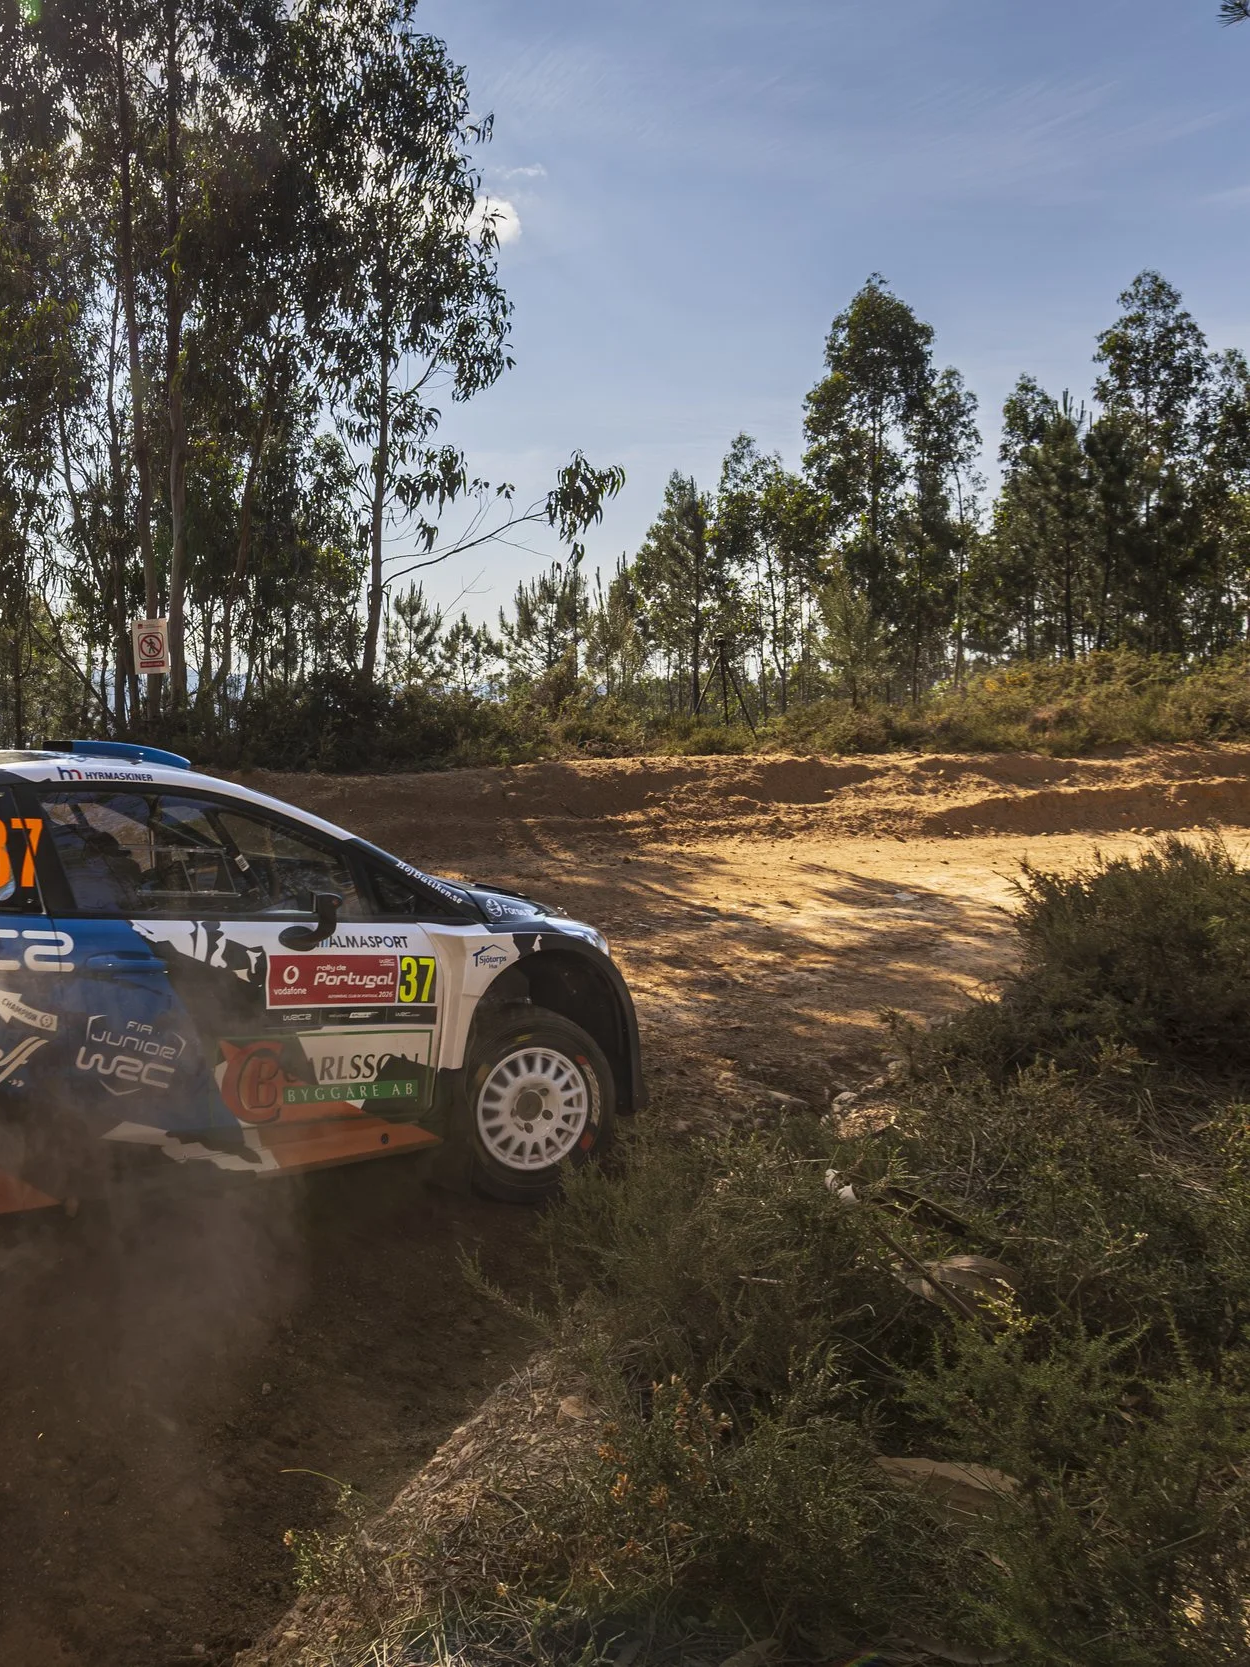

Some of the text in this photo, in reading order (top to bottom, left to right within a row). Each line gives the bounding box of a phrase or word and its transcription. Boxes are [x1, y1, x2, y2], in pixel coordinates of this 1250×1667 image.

[85, 771, 154, 782] HYRMASKINER
[316, 964, 336, 972] rally
[479, 955, 507, 966] Sjötorps
[313, 972, 395, 989] Portugal
[400, 956, 436, 1003] 37
[273, 987, 307, 996] vodafone
[1, 998, 38, 1022] CHAMPION
[126, 1020, 153, 1035] FIA
[91, 1030, 176, 1060] JUNIOR
[75, 1045, 175, 1089] WRC
[287, 1082, 413, 1103] BYGGARE AB
